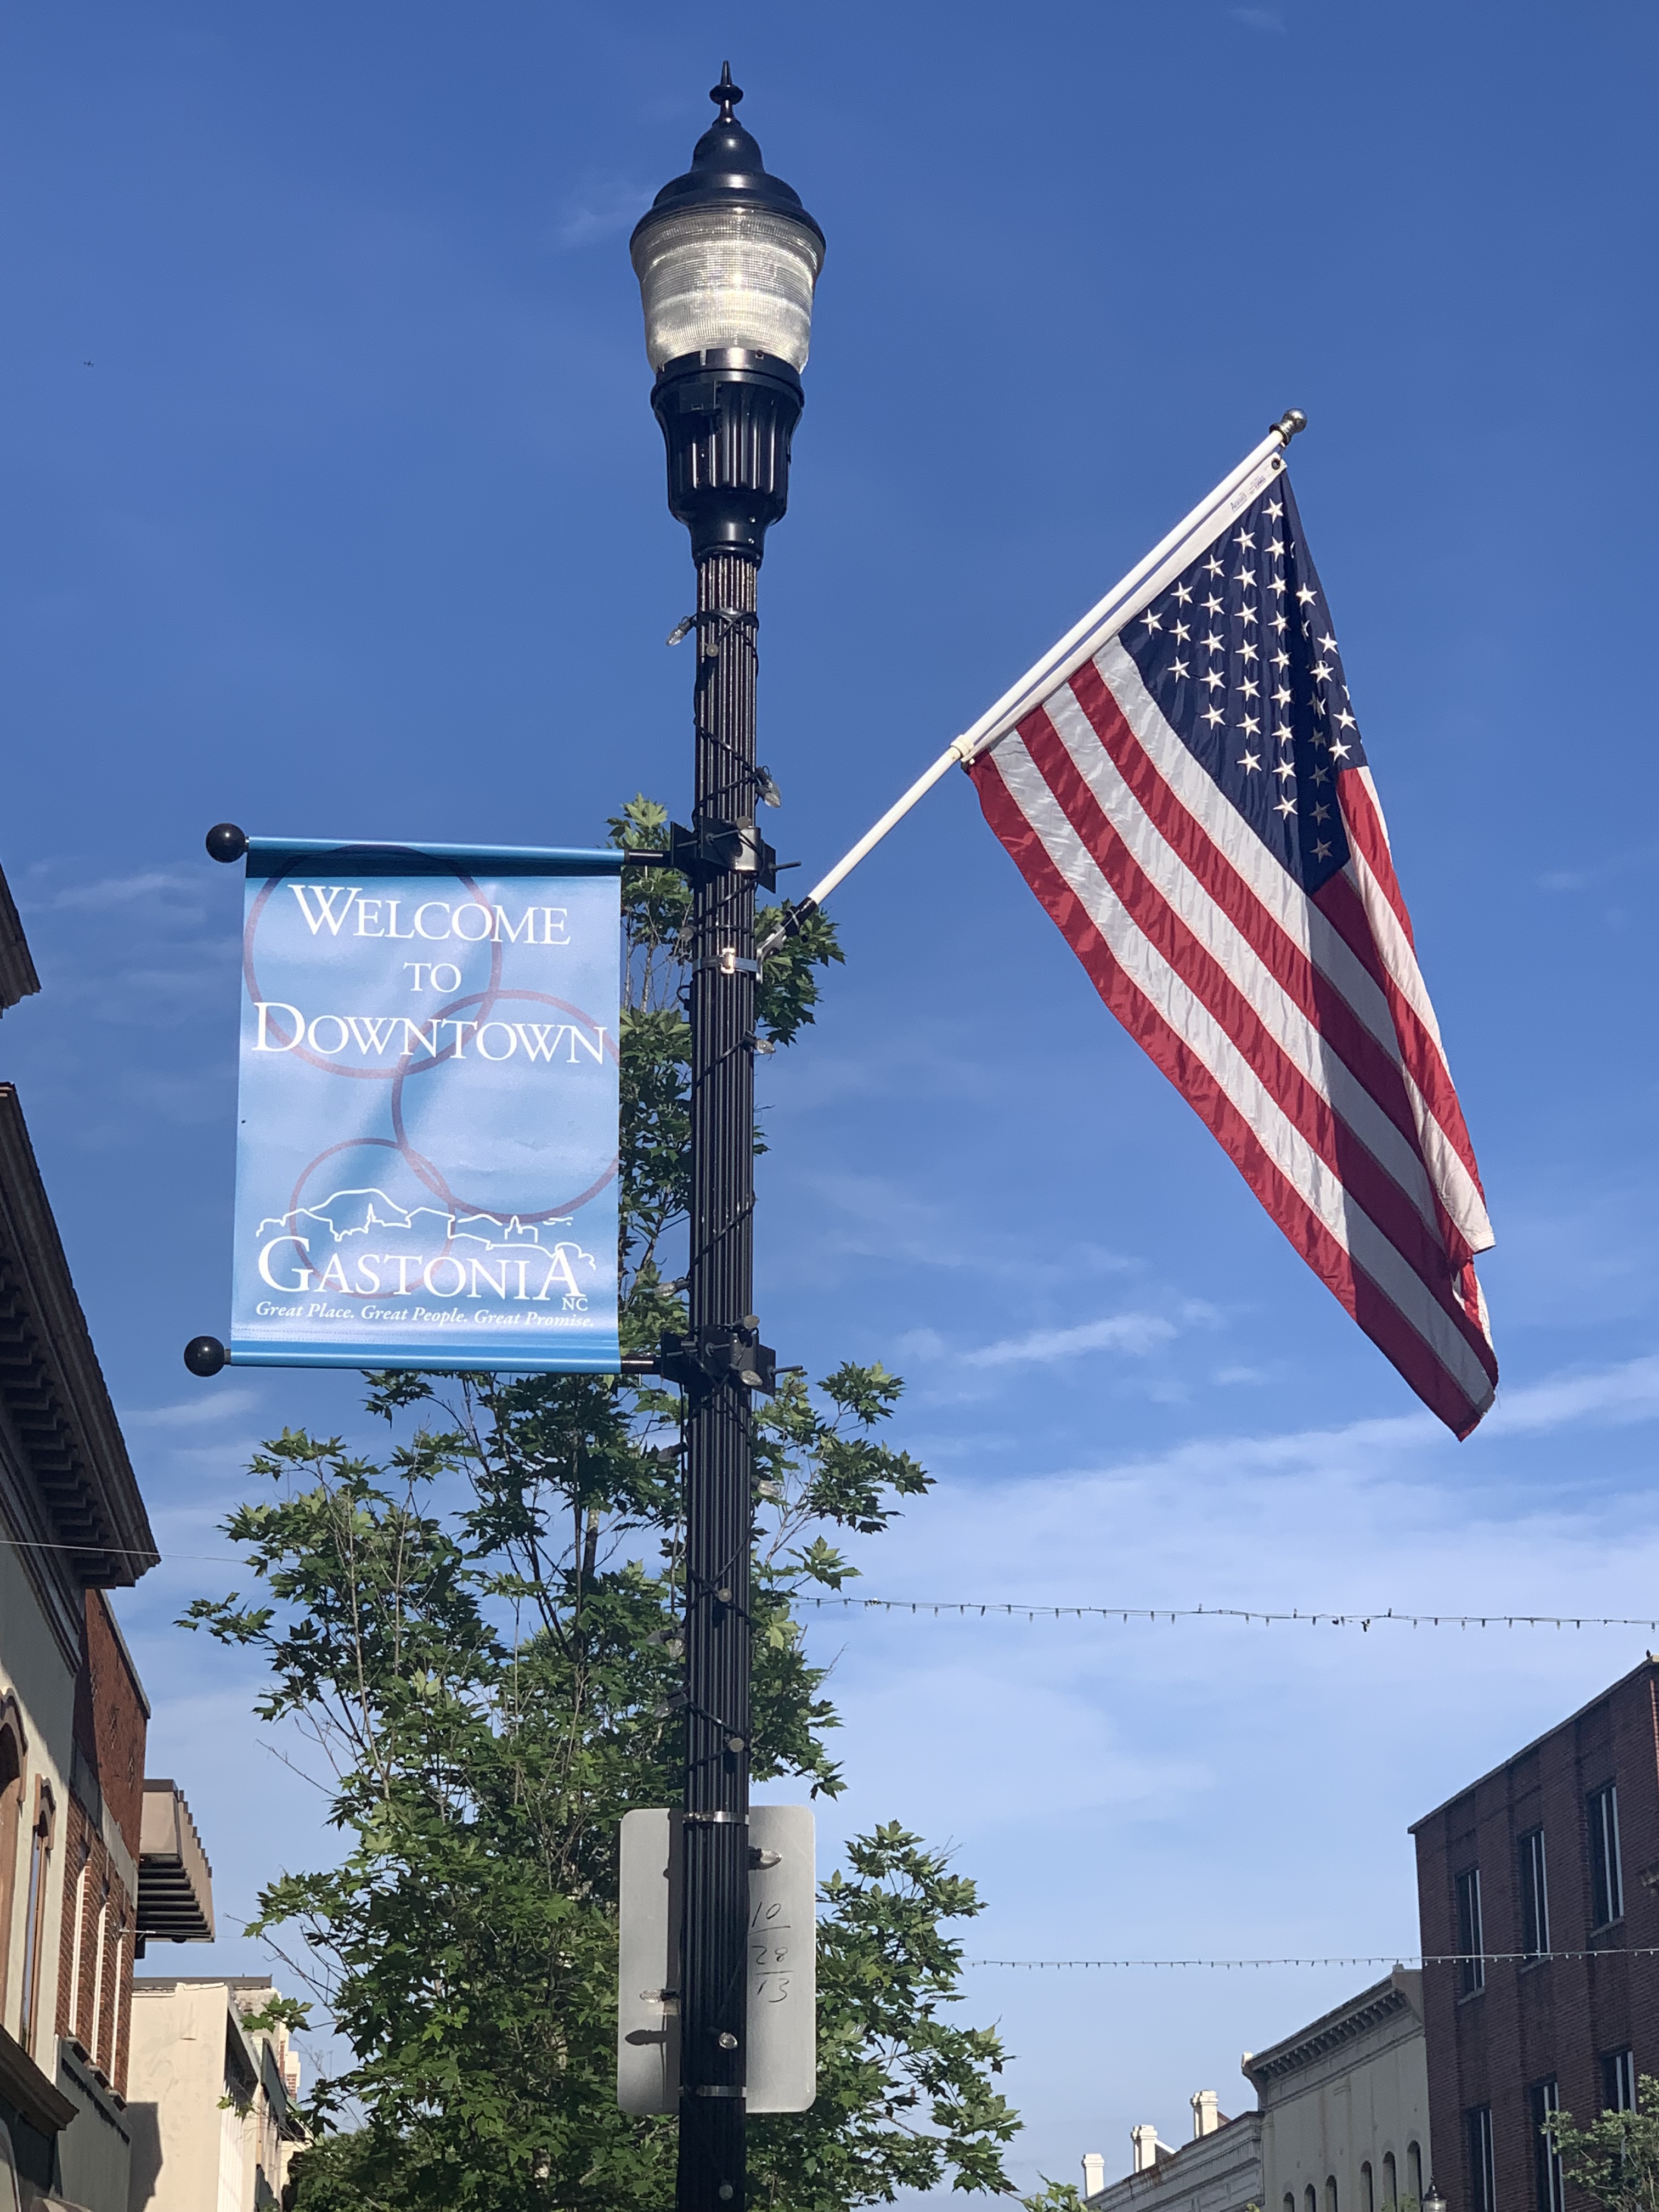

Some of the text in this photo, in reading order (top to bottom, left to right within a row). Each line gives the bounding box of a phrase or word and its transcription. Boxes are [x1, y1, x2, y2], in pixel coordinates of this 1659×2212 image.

[287, 884, 571, 945] WELCOME
[403, 962, 461, 993] TO
[252, 1002, 607, 1065] DOWNTOWN
[258, 1236, 586, 1300] GASTONIA
[256, 1301, 595, 1327] Great Place. Great People. Great Promise.
[561, 1297, 588, 1311] NC
[752, 1901, 782, 1928] 10
[752, 1945, 789, 1965] 28
[757, 1978, 790, 2002] 13
